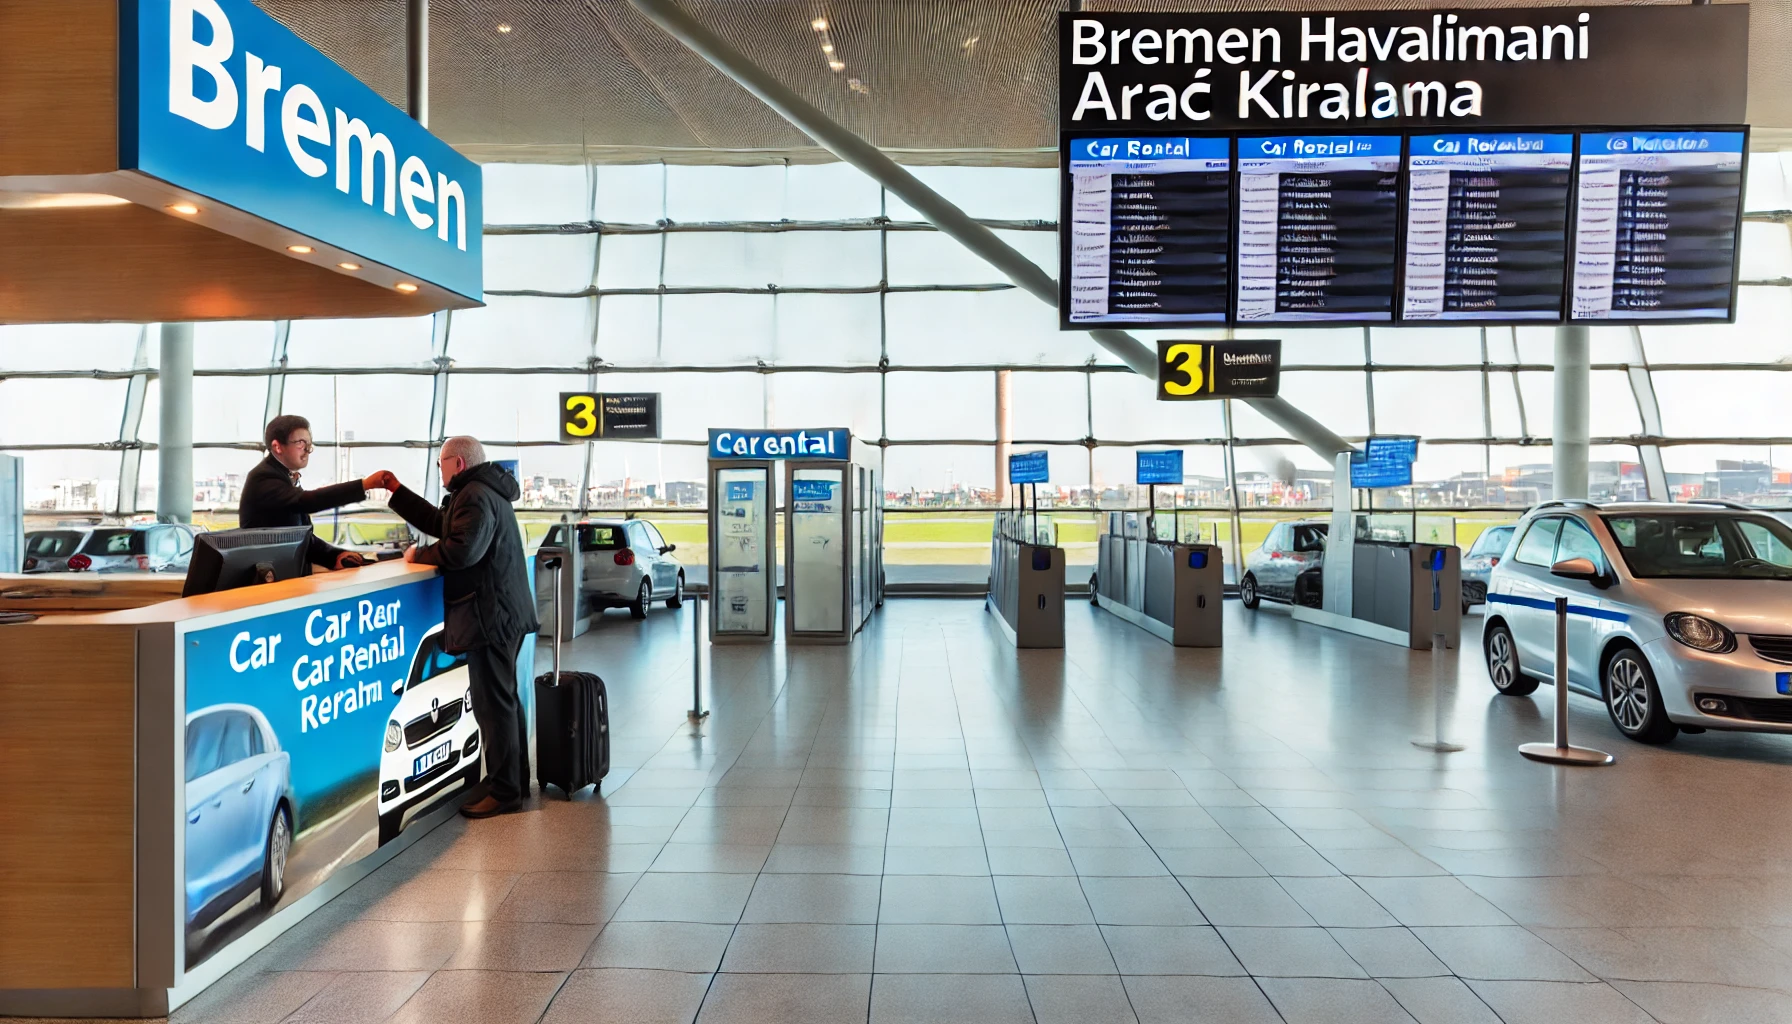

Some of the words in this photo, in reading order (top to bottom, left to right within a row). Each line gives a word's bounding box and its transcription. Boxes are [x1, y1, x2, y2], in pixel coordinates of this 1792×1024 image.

[1072, 19, 1281, 65] Bremen
[1301, 13, 1590, 63] Havalimani
[1238, 67, 1483, 121] Kiralama
[169, 0, 467, 253] Bremen
[1164, 343, 1204, 396] 3
[565, 395, 597, 437] 3
[229, 631, 282, 673] Car
[304, 608, 352, 647] Car
[291, 654, 335, 691] Car
